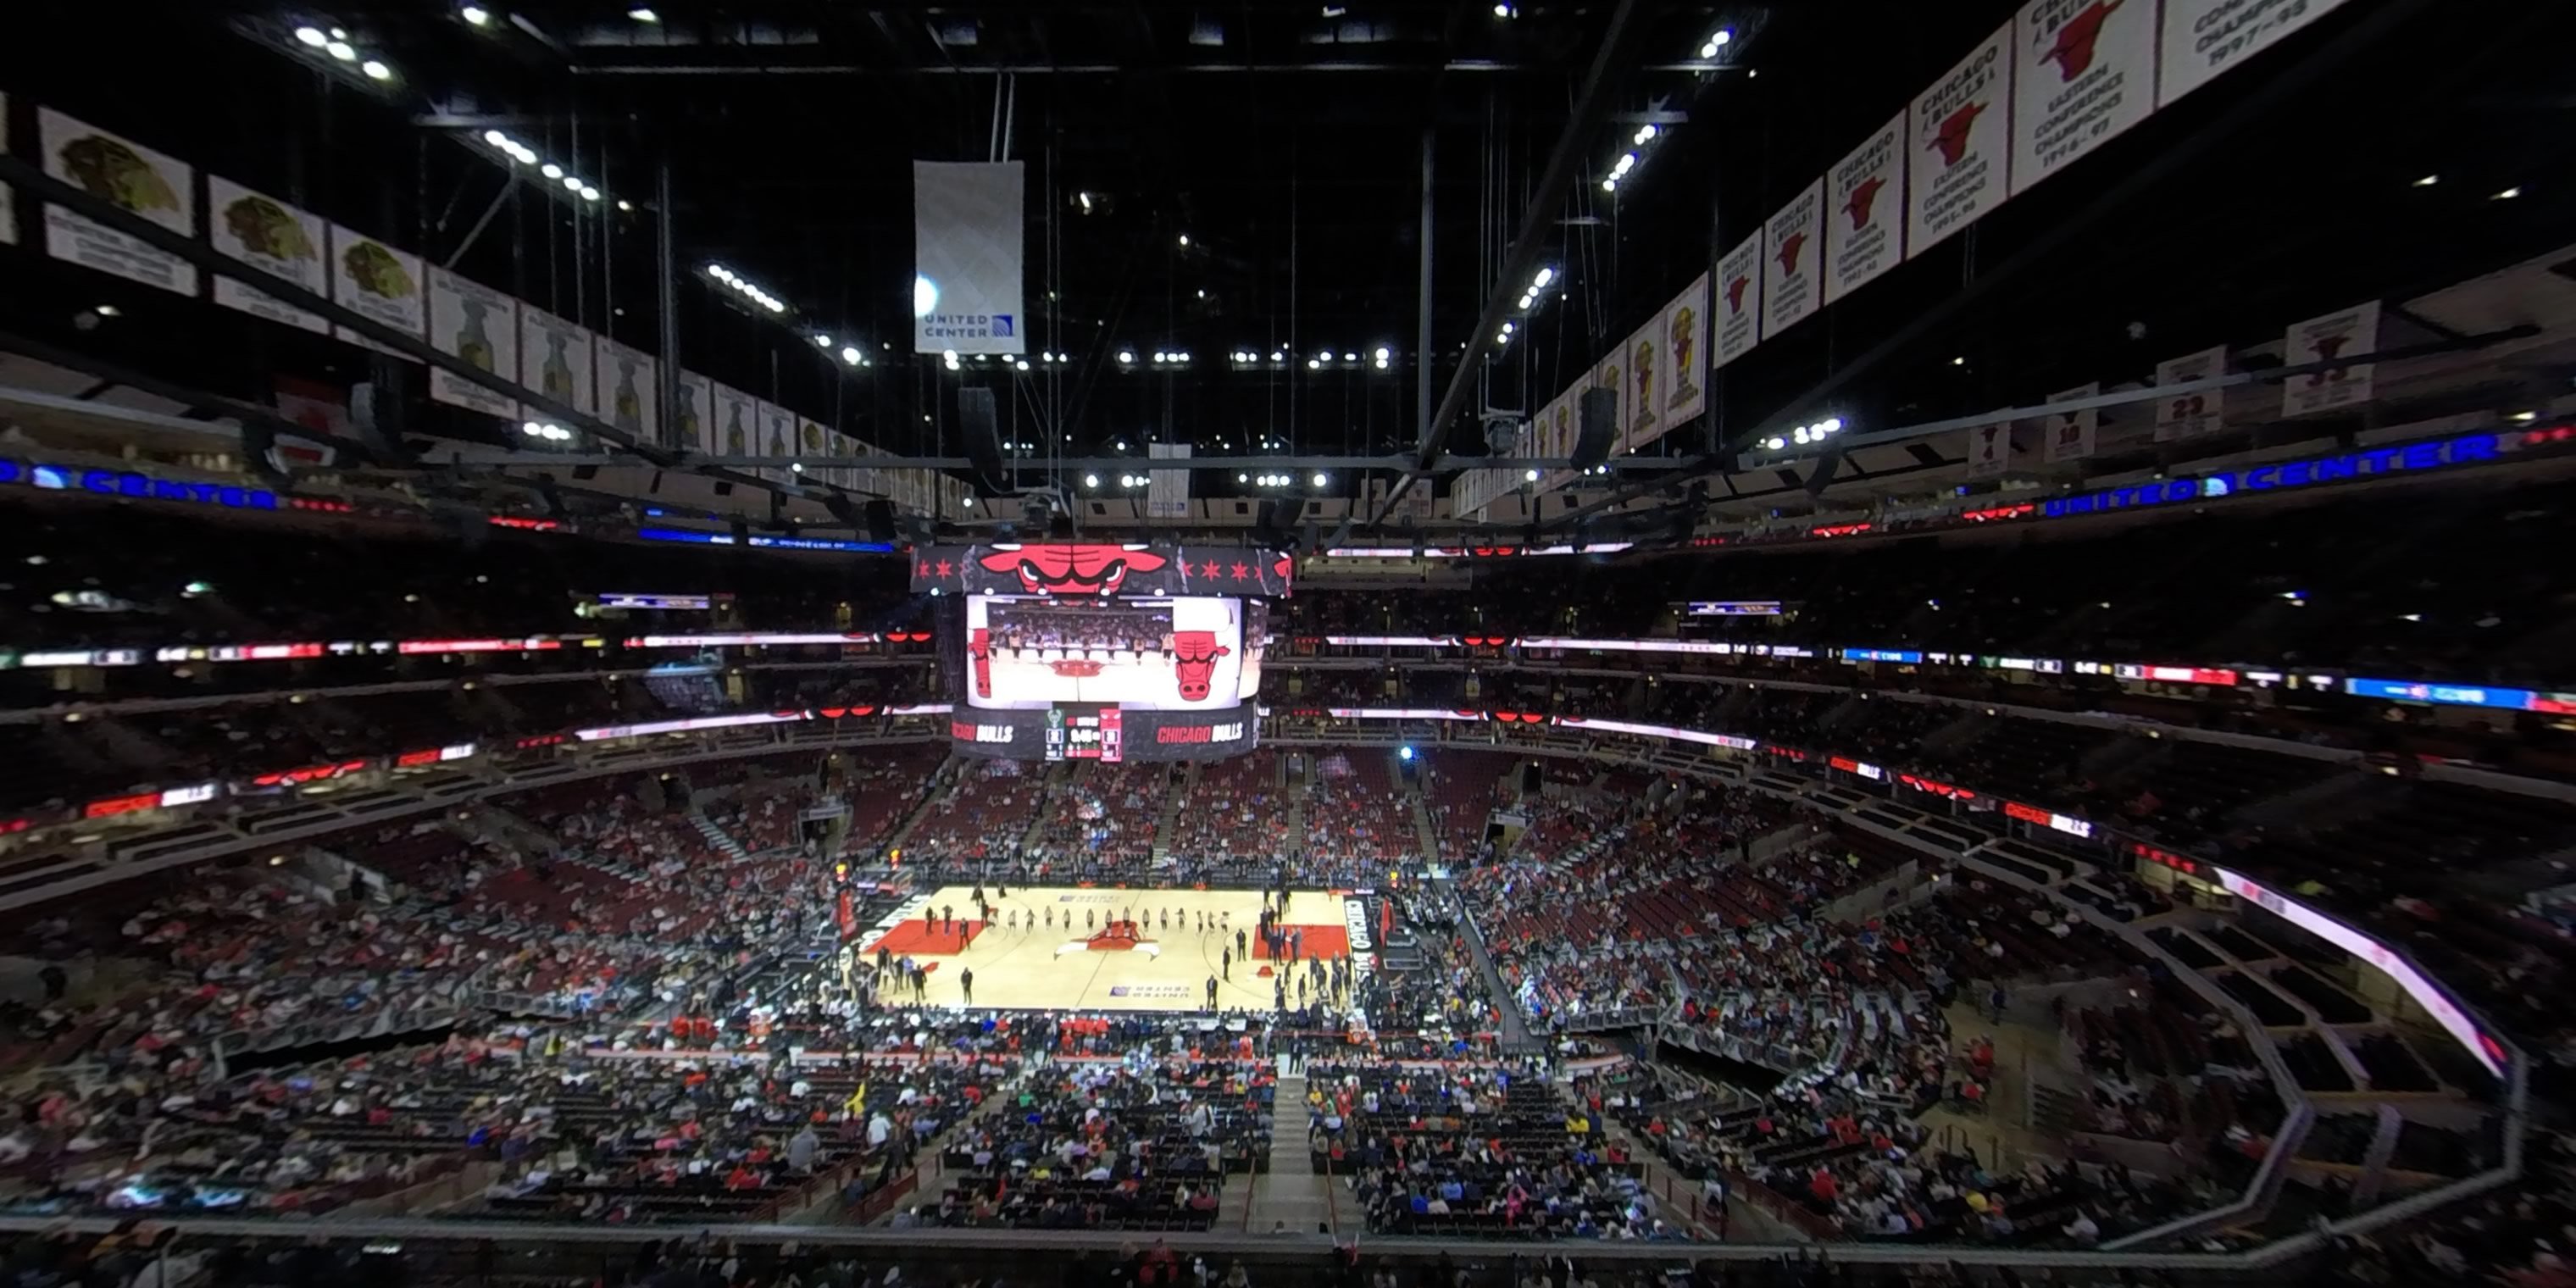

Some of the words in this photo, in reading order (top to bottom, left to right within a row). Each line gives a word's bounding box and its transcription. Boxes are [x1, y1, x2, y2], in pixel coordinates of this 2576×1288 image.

[1921, 44, 1998, 116] CHICAGO
[1931, 73, 1985, 126] BULLS
[1837, 130, 1894, 183] CHICAGO
[1845, 154, 1884, 193] BULLS
[924, 314, 988, 325] UNITED
[924, 327, 988, 338] CENTER
[2172, 396, 2203, 419] 23
[2046, 478, 2197, 518] UNITED
[2246, 434, 2497, 491] CENTER
[976, 724, 1013, 743] BULLS
[1157, 725, 1211, 743] CHICAGO
[1212, 721, 1243, 742] BULLS
[1345, 900, 1372, 949] CHICAGO
